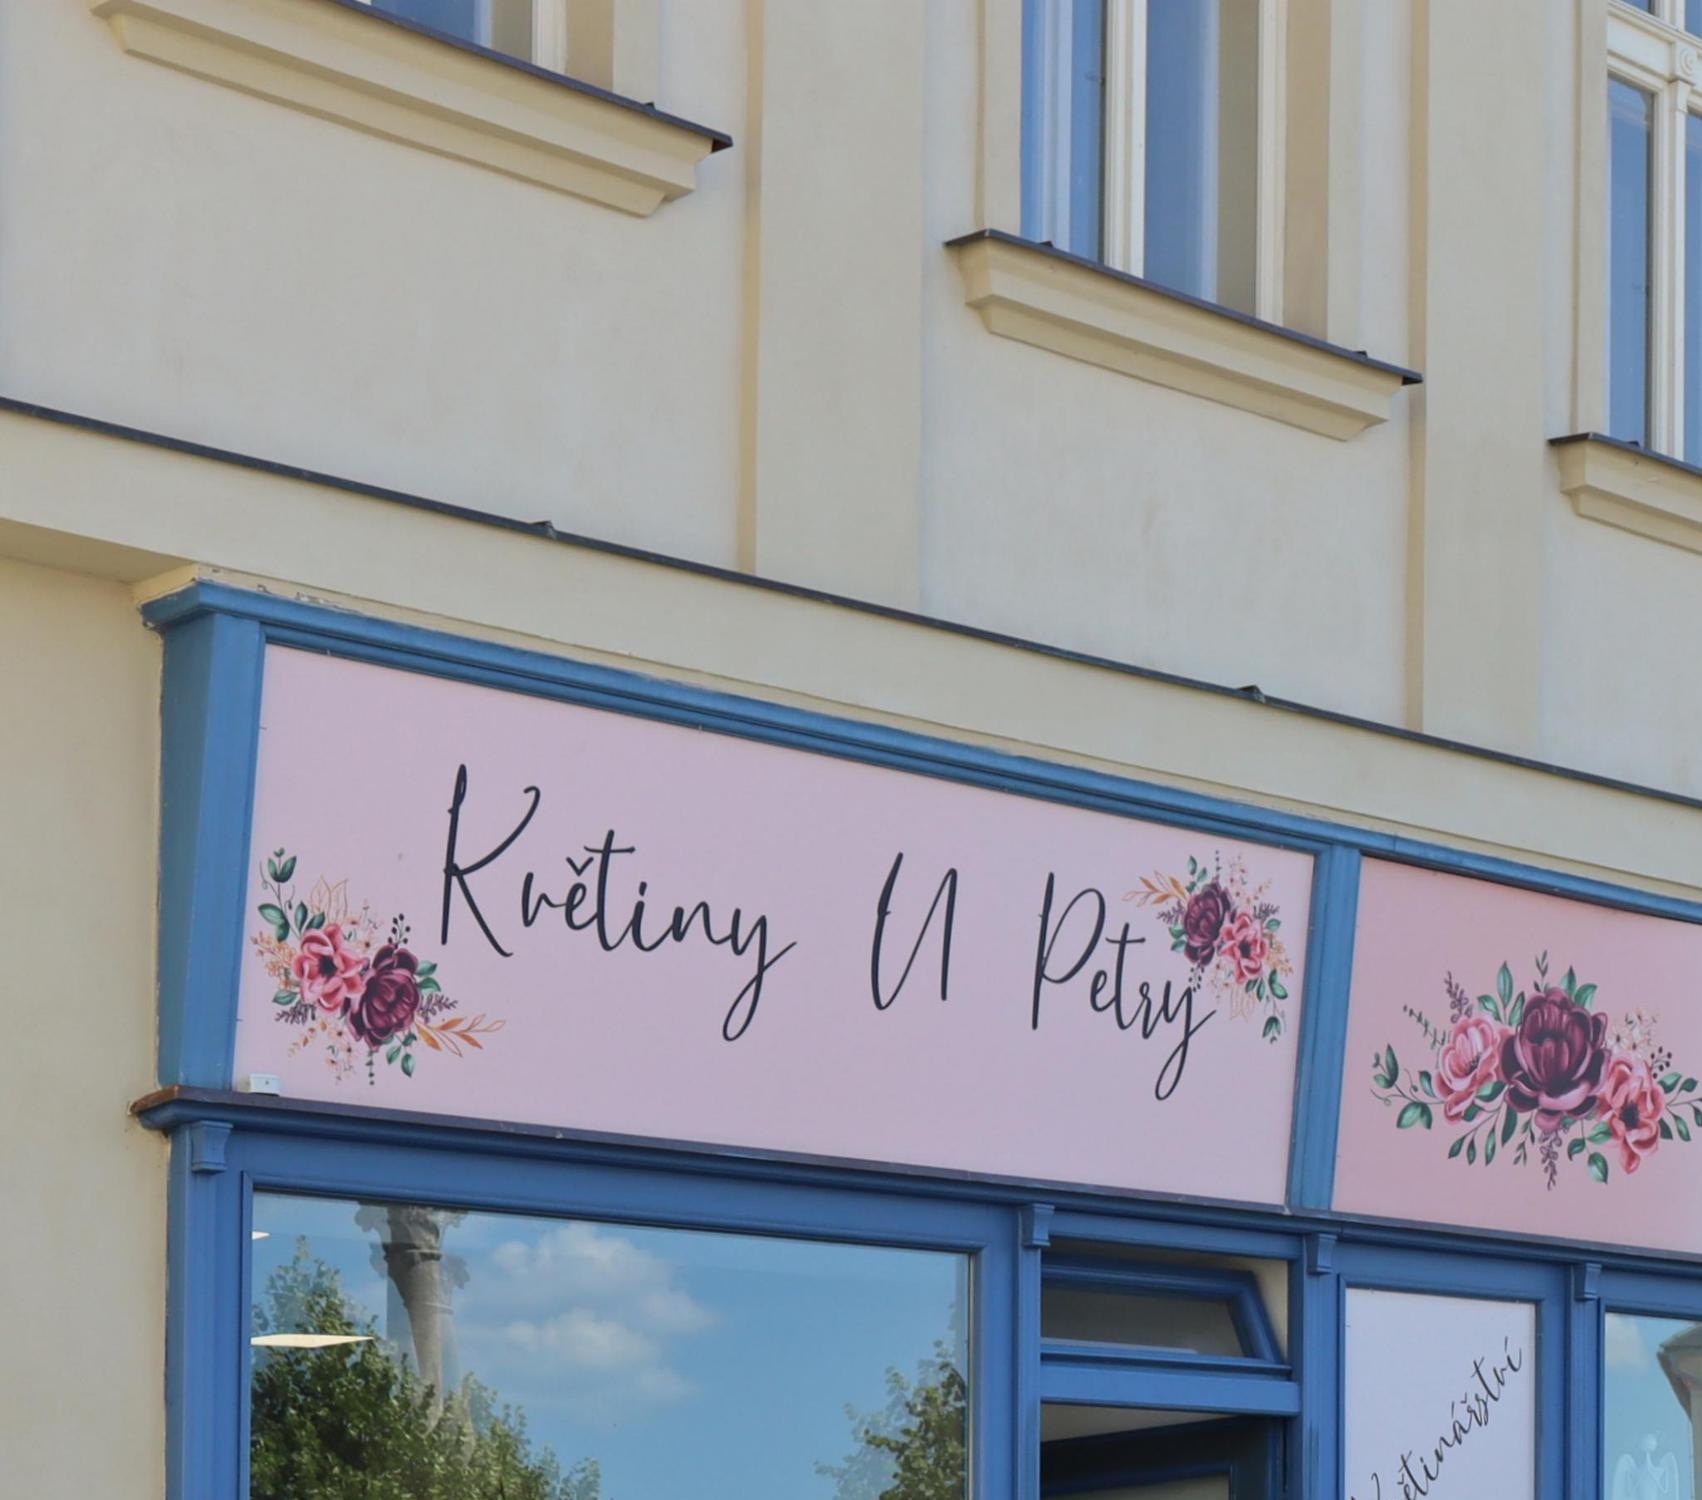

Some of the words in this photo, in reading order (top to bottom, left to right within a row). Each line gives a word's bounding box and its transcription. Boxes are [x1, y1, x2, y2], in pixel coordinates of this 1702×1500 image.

[440, 763, 796, 1042] Květiny
[869, 851, 958, 1012] U
[1031, 871, 1216, 1102] Petry
